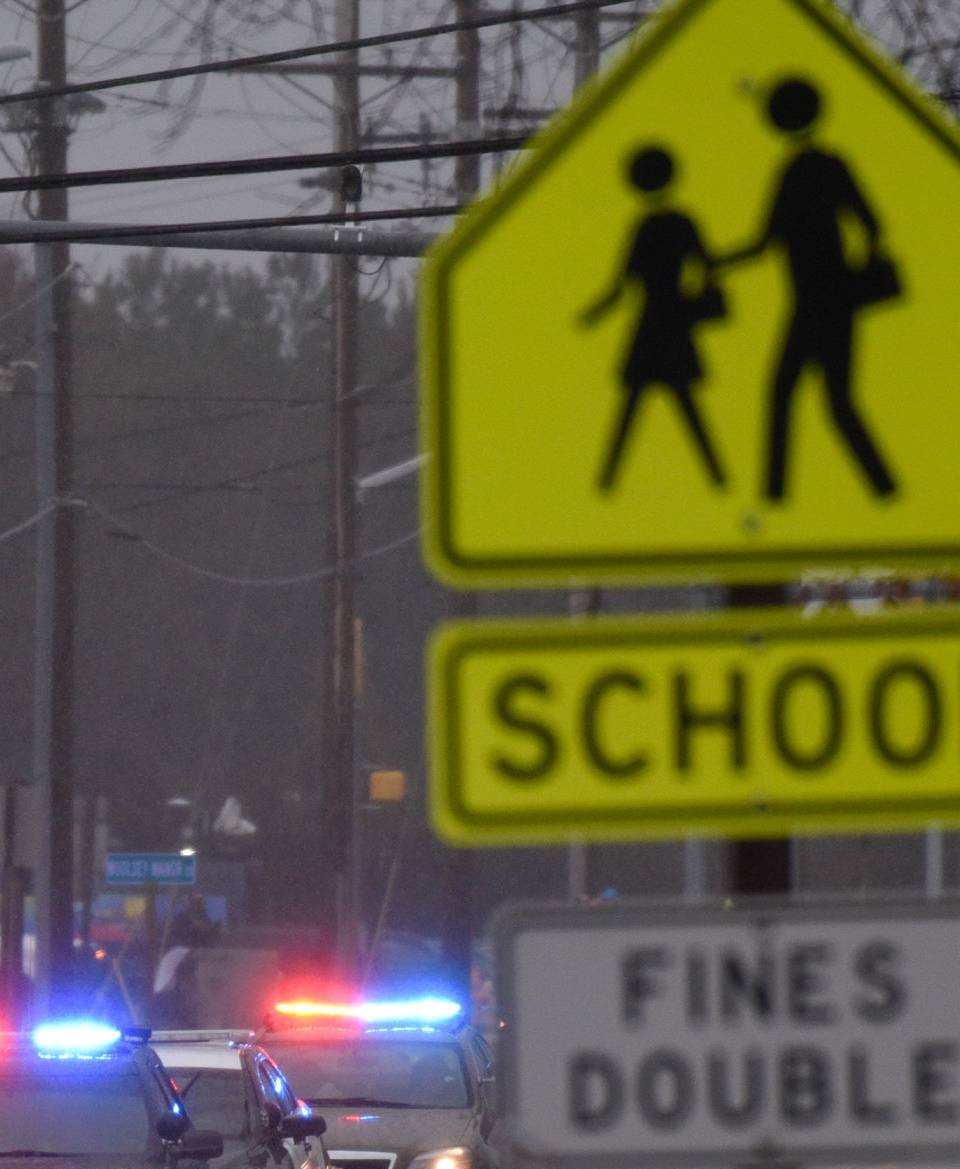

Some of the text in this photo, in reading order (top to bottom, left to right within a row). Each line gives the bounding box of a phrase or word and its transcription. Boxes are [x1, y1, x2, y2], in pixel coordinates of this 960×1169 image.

[492, 659, 960, 782] SCHOO
[620, 940, 908, 1029] FINES
[566, 1041, 960, 1135] DOUBLE
